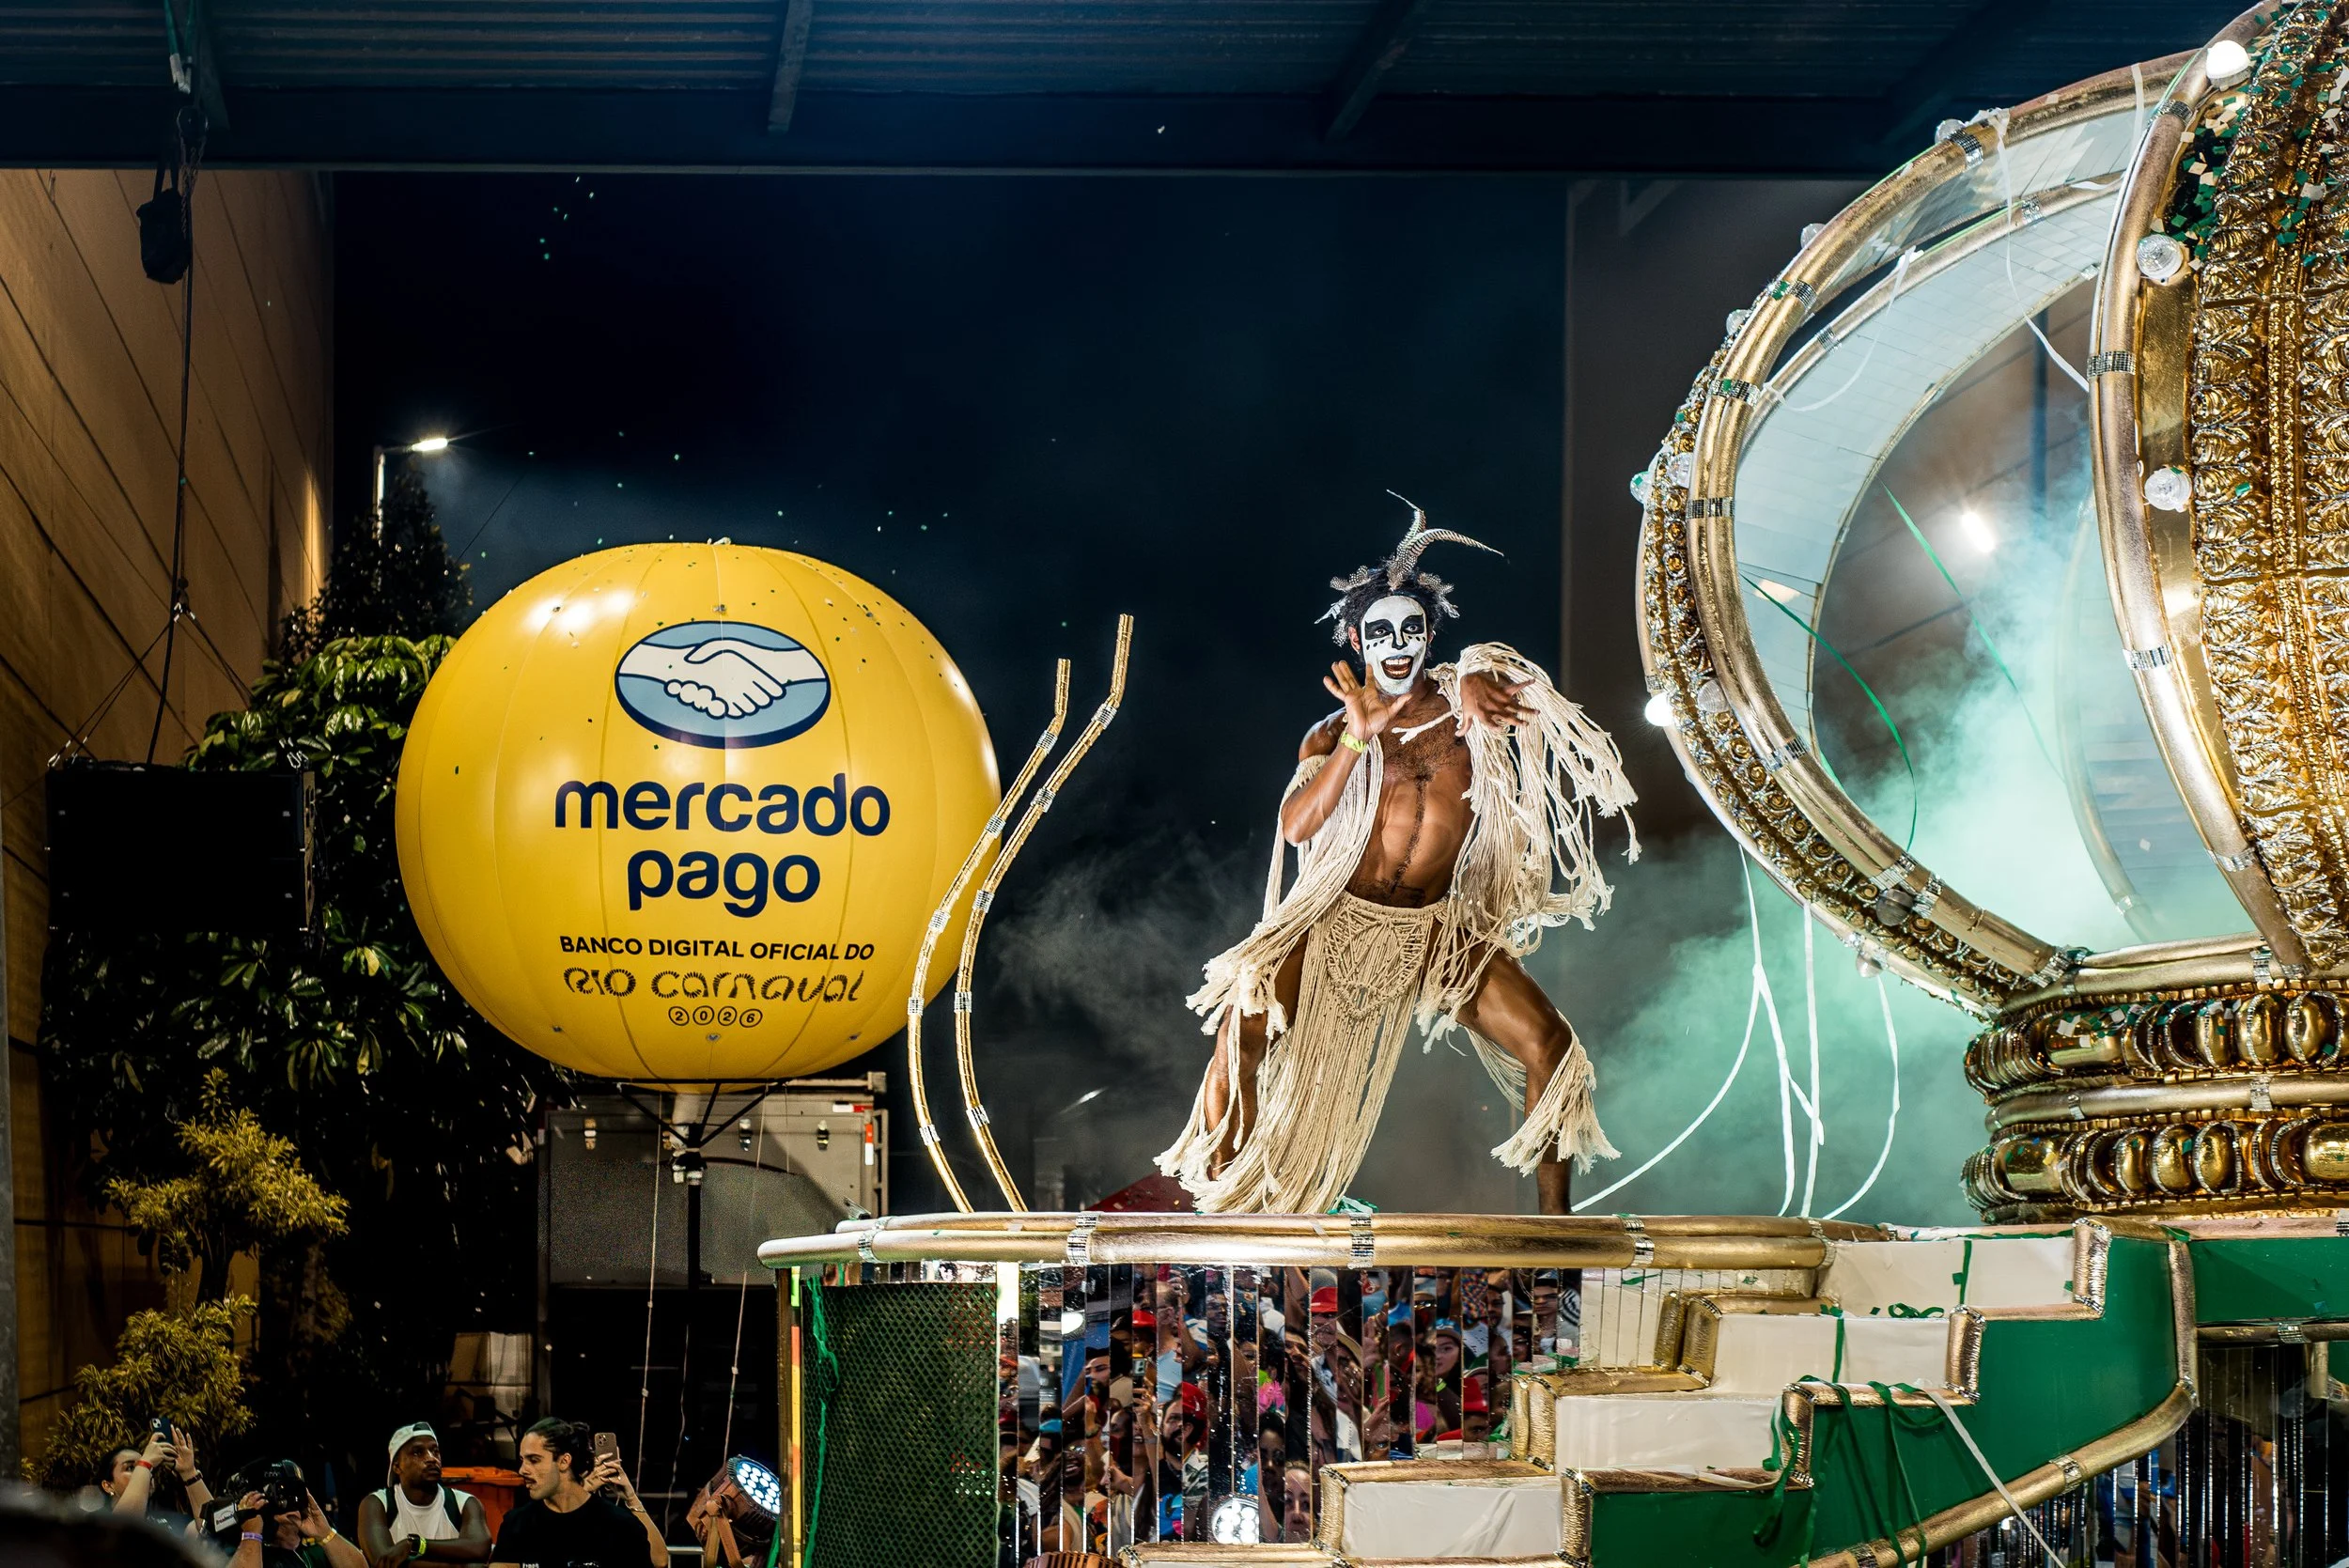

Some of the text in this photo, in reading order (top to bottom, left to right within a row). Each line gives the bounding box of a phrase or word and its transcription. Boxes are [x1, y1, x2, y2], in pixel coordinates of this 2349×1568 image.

[554, 772, 891, 836] mercado
[628, 849, 821, 918] pago
[560, 936, 875, 960] BANCO DIGITAL OFICIAL DO
[670, 1006, 761, 1027] 2026
